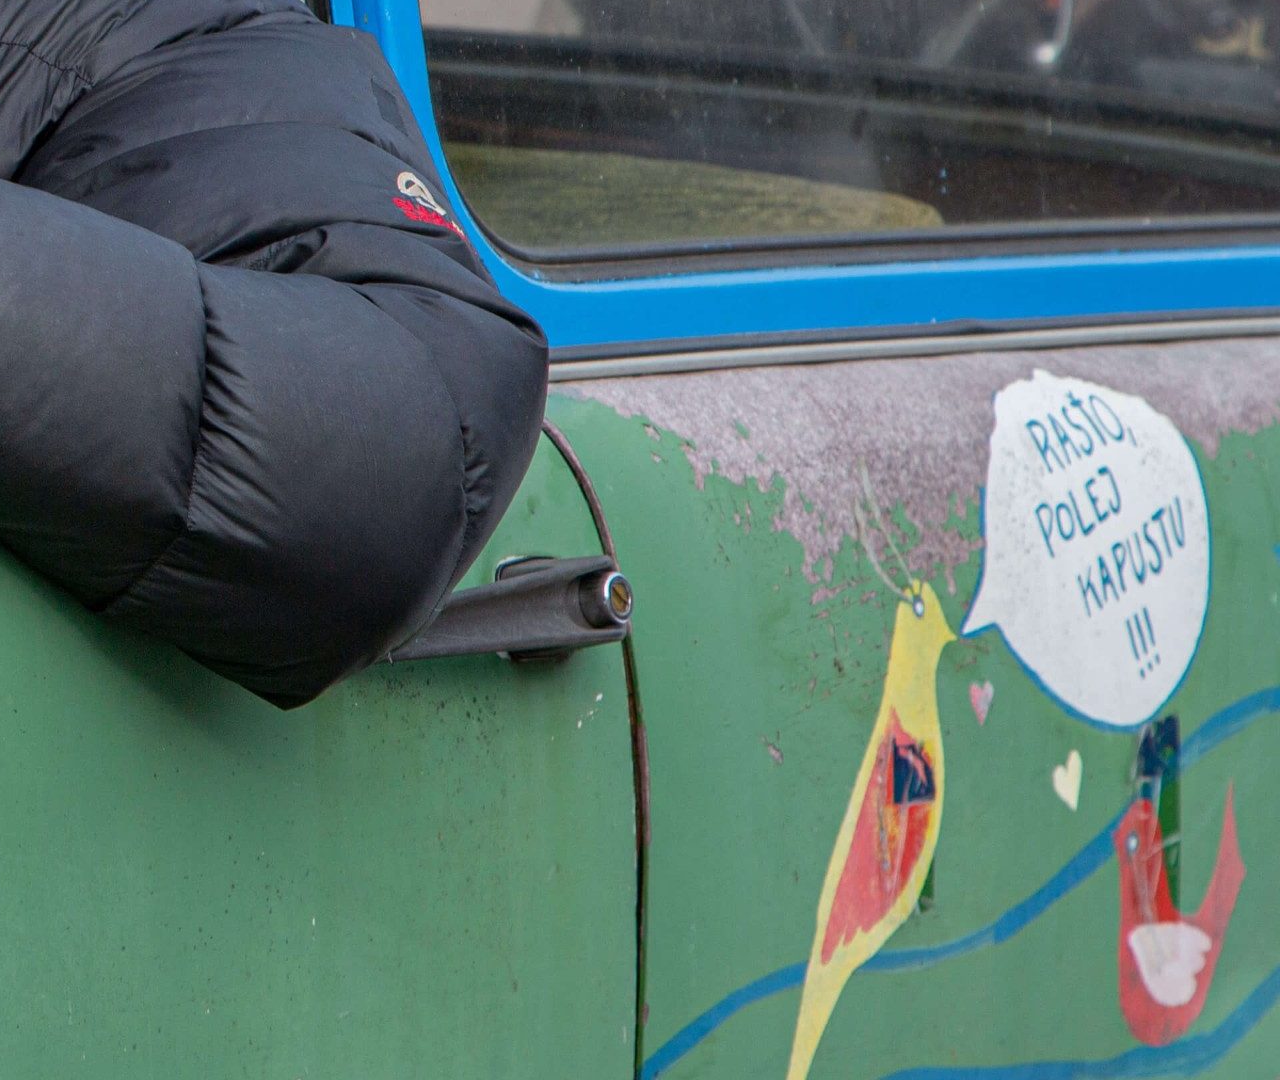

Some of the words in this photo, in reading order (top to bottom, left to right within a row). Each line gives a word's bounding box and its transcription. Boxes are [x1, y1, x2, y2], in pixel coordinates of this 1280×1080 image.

[1035, 466, 1122, 558] POLEJ
[1077, 497, 1186, 617] KAPUSTU
[1126, 607, 1161, 678] !!!
